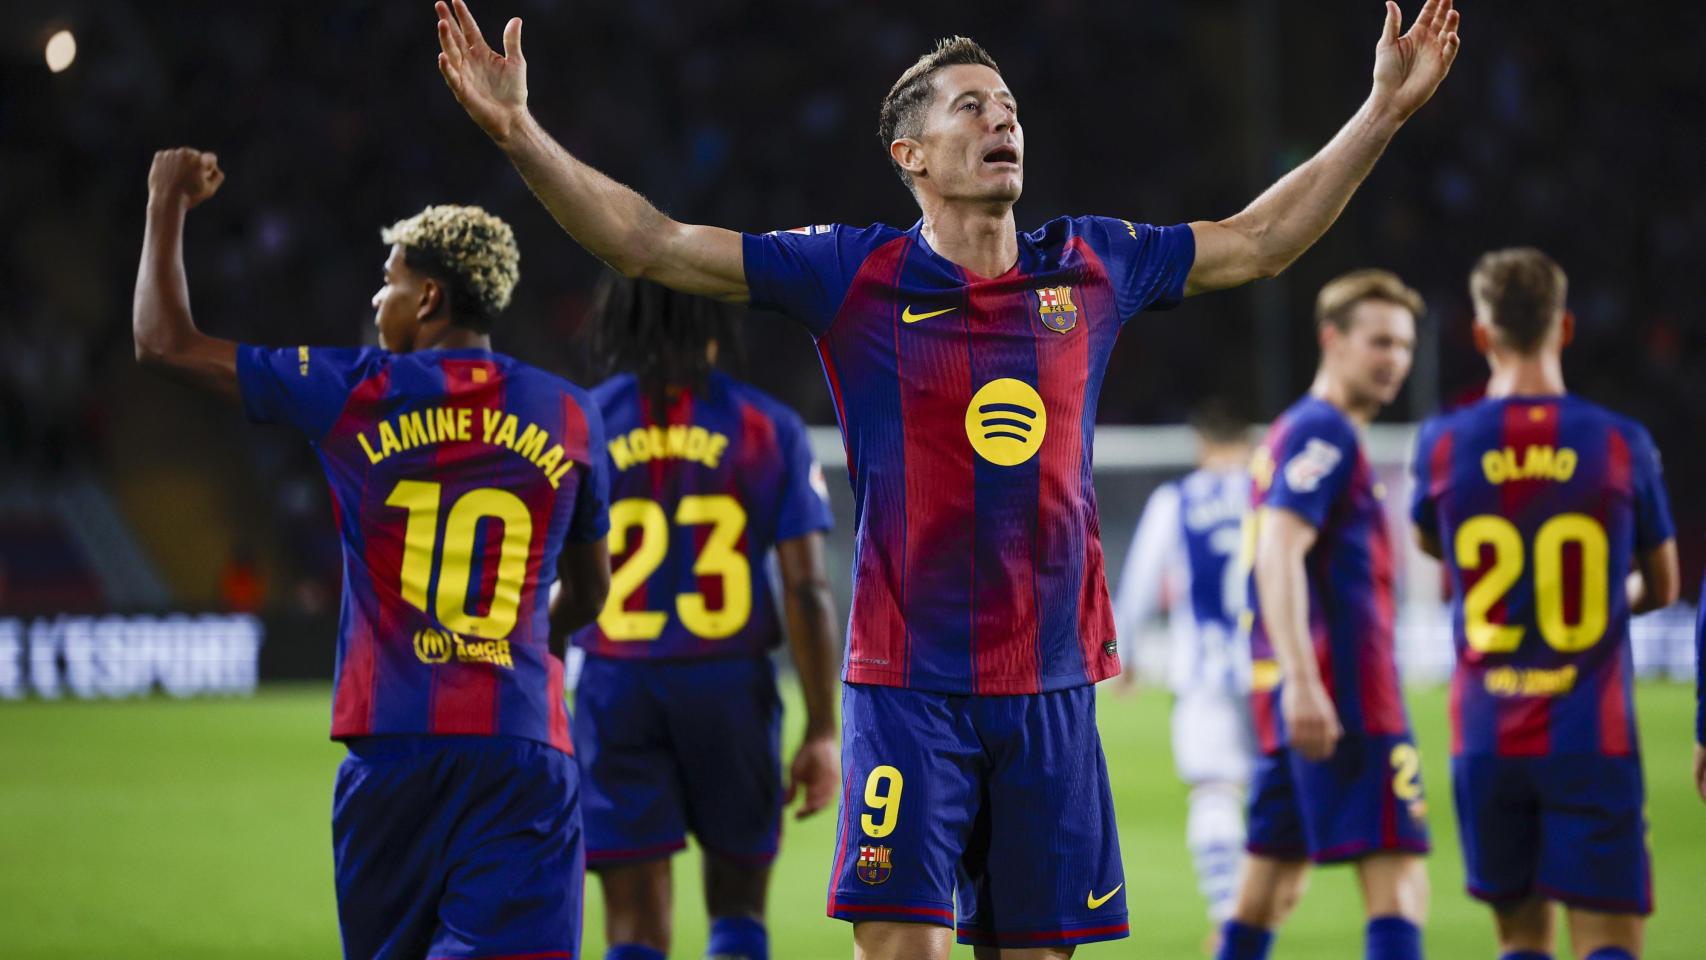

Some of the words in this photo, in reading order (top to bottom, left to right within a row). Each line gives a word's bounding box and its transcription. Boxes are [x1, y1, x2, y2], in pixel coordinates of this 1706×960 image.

[357, 408, 471, 464] LAMINE
[483, 408, 574, 489] YAMAL
[1481, 445, 1577, 484] OLMO
[384, 480, 532, 639] 10
[597, 495, 752, 641] 23
[1455, 513, 1609, 653] 20
[861, 765, 903, 837] 9
